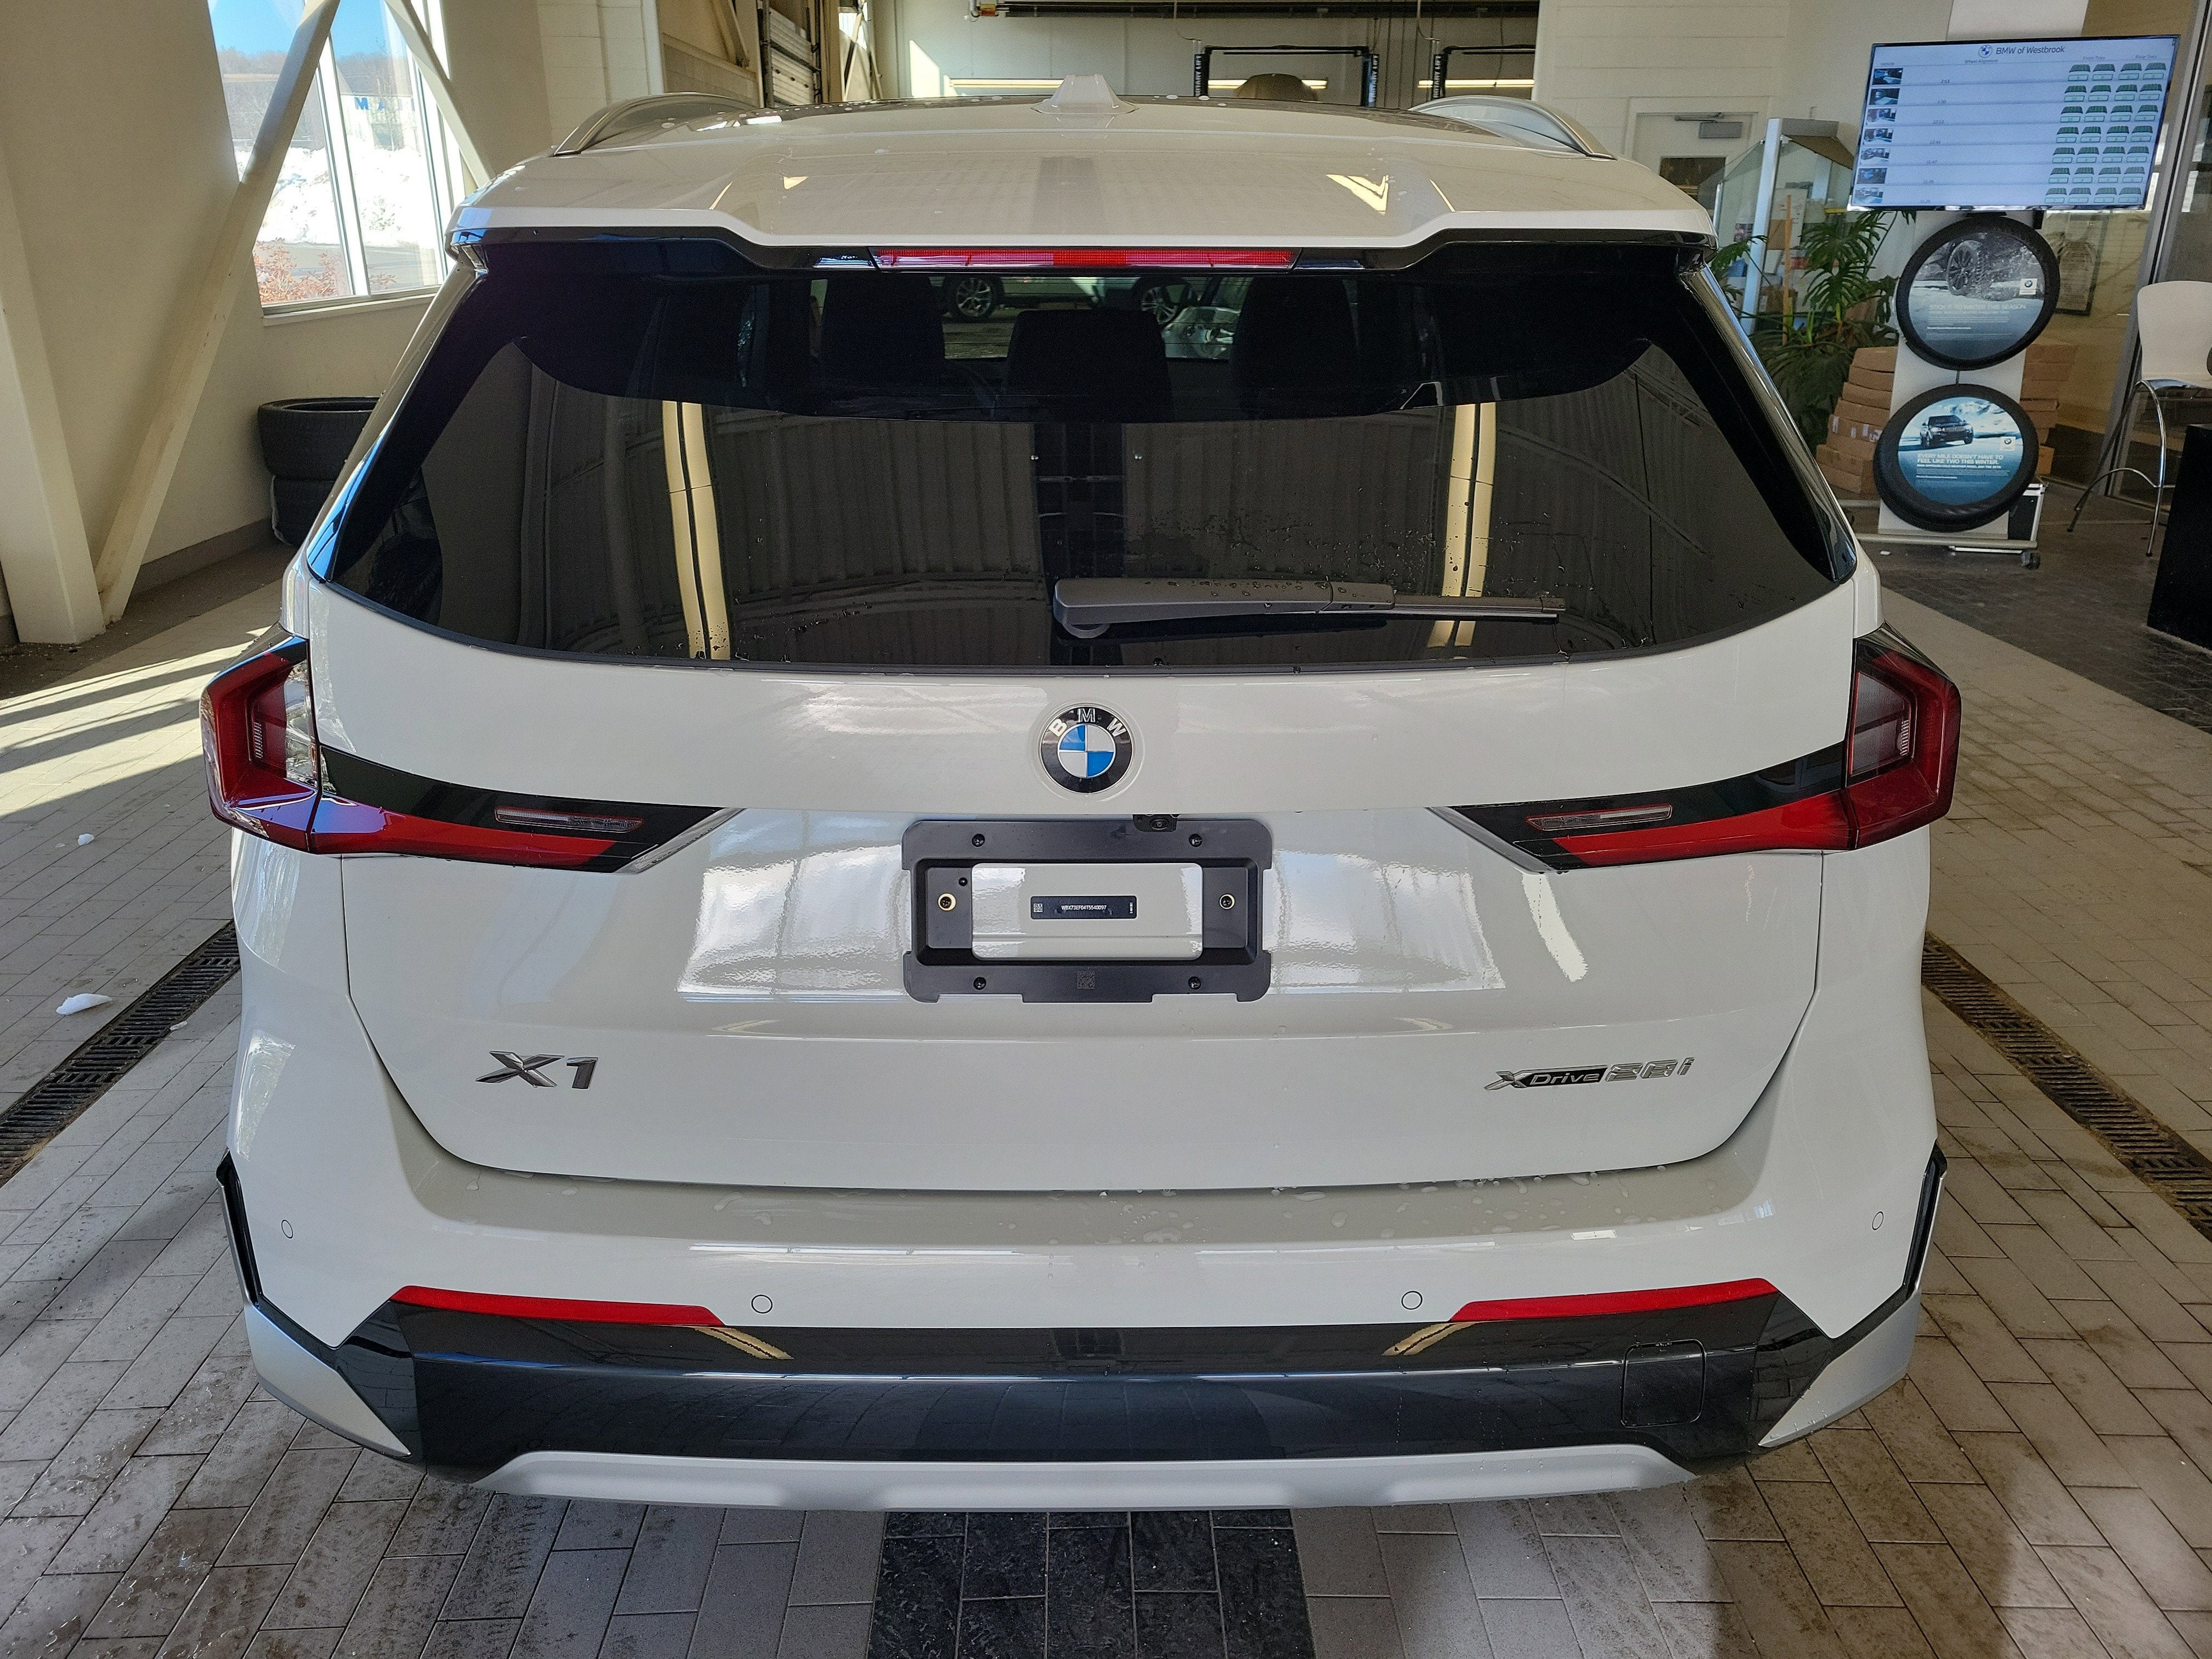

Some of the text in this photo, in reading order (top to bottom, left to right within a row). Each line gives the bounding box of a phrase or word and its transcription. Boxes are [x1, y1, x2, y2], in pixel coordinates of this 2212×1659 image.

[1996, 45, 2065, 54] BMW of Westbrook
[1048, 708, 1126, 737] BMW
[475, 1051, 599, 1089] X1
